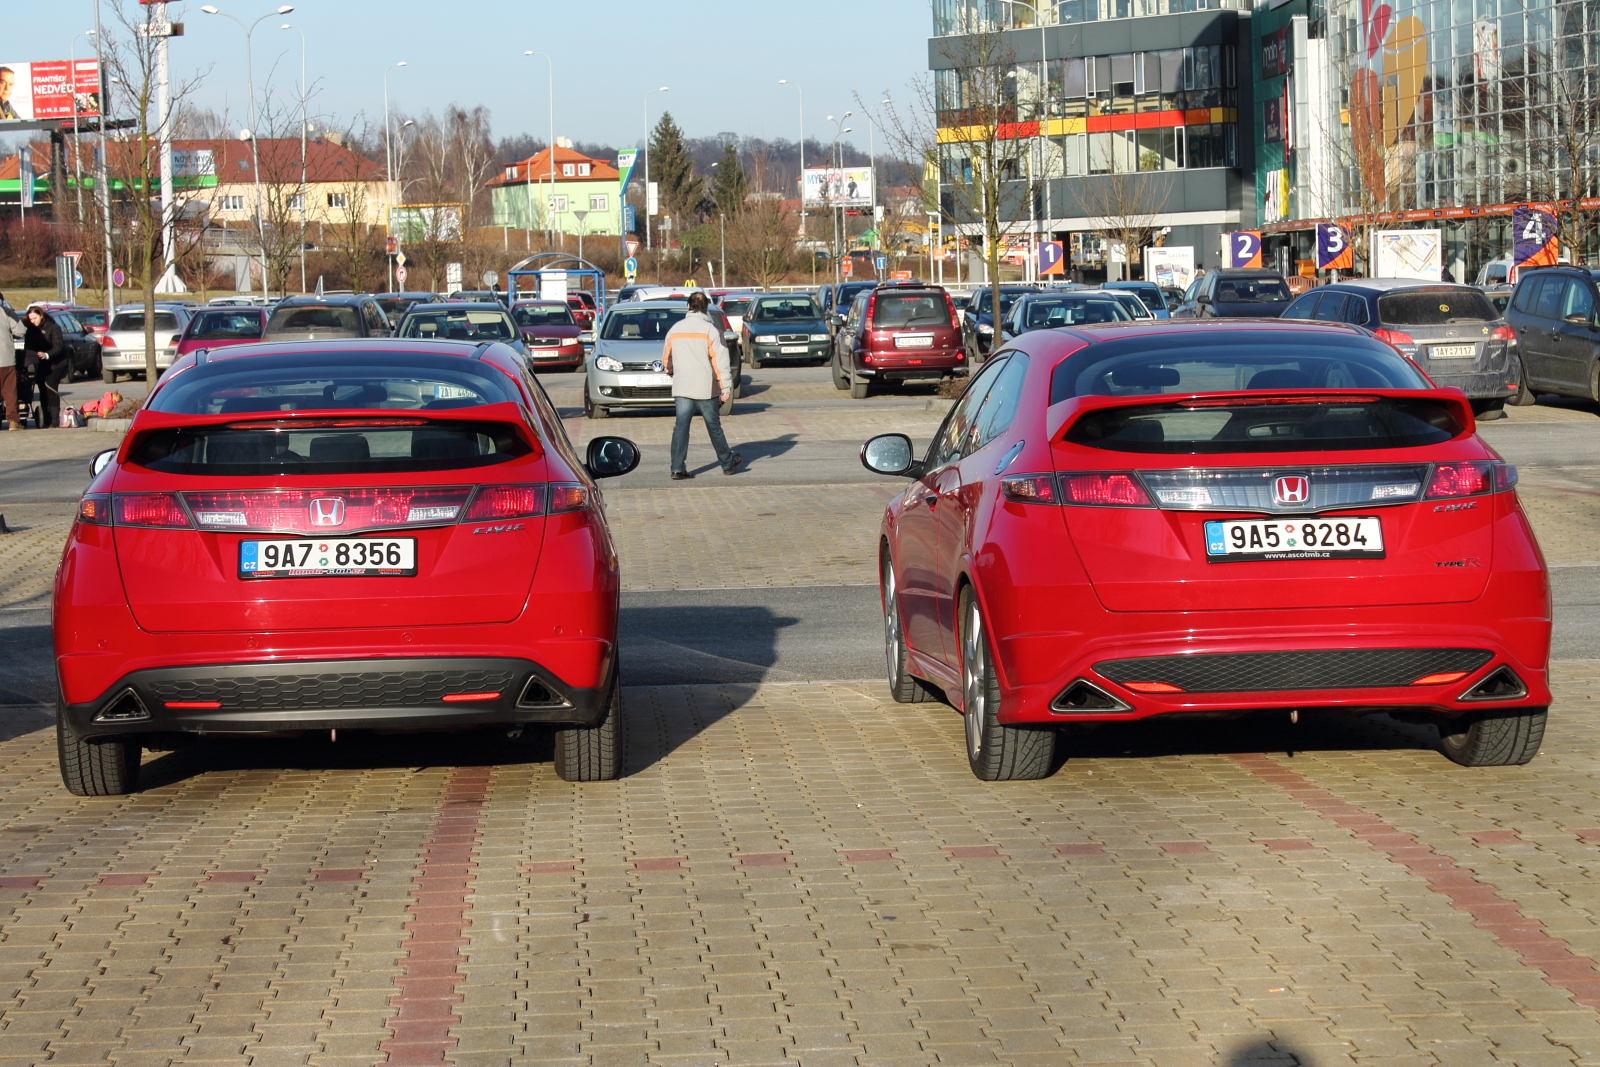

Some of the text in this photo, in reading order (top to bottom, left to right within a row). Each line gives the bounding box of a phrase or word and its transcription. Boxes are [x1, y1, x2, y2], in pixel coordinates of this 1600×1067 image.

[33, 74, 67, 83] FRANTIŠEK
[1522, 213, 1546, 245] 4
[1327, 226, 1343, 253] 3
[1044, 244, 1055, 263] 1
[1237, 235, 1253, 259] 2
[1435, 346, 1472, 356] 1AY 7117
[1433, 501, 1478, 513] CIVIC
[473, 522, 525, 535] CIVIC
[1230, 522, 1368, 549] 9A5 8284
[1211, 543, 1224, 551] CZ
[264, 542, 401, 568] 9A7 8356
[1264, 551, 1331, 559] www.ascotmb.cz
[243, 561, 256, 570] CZ
